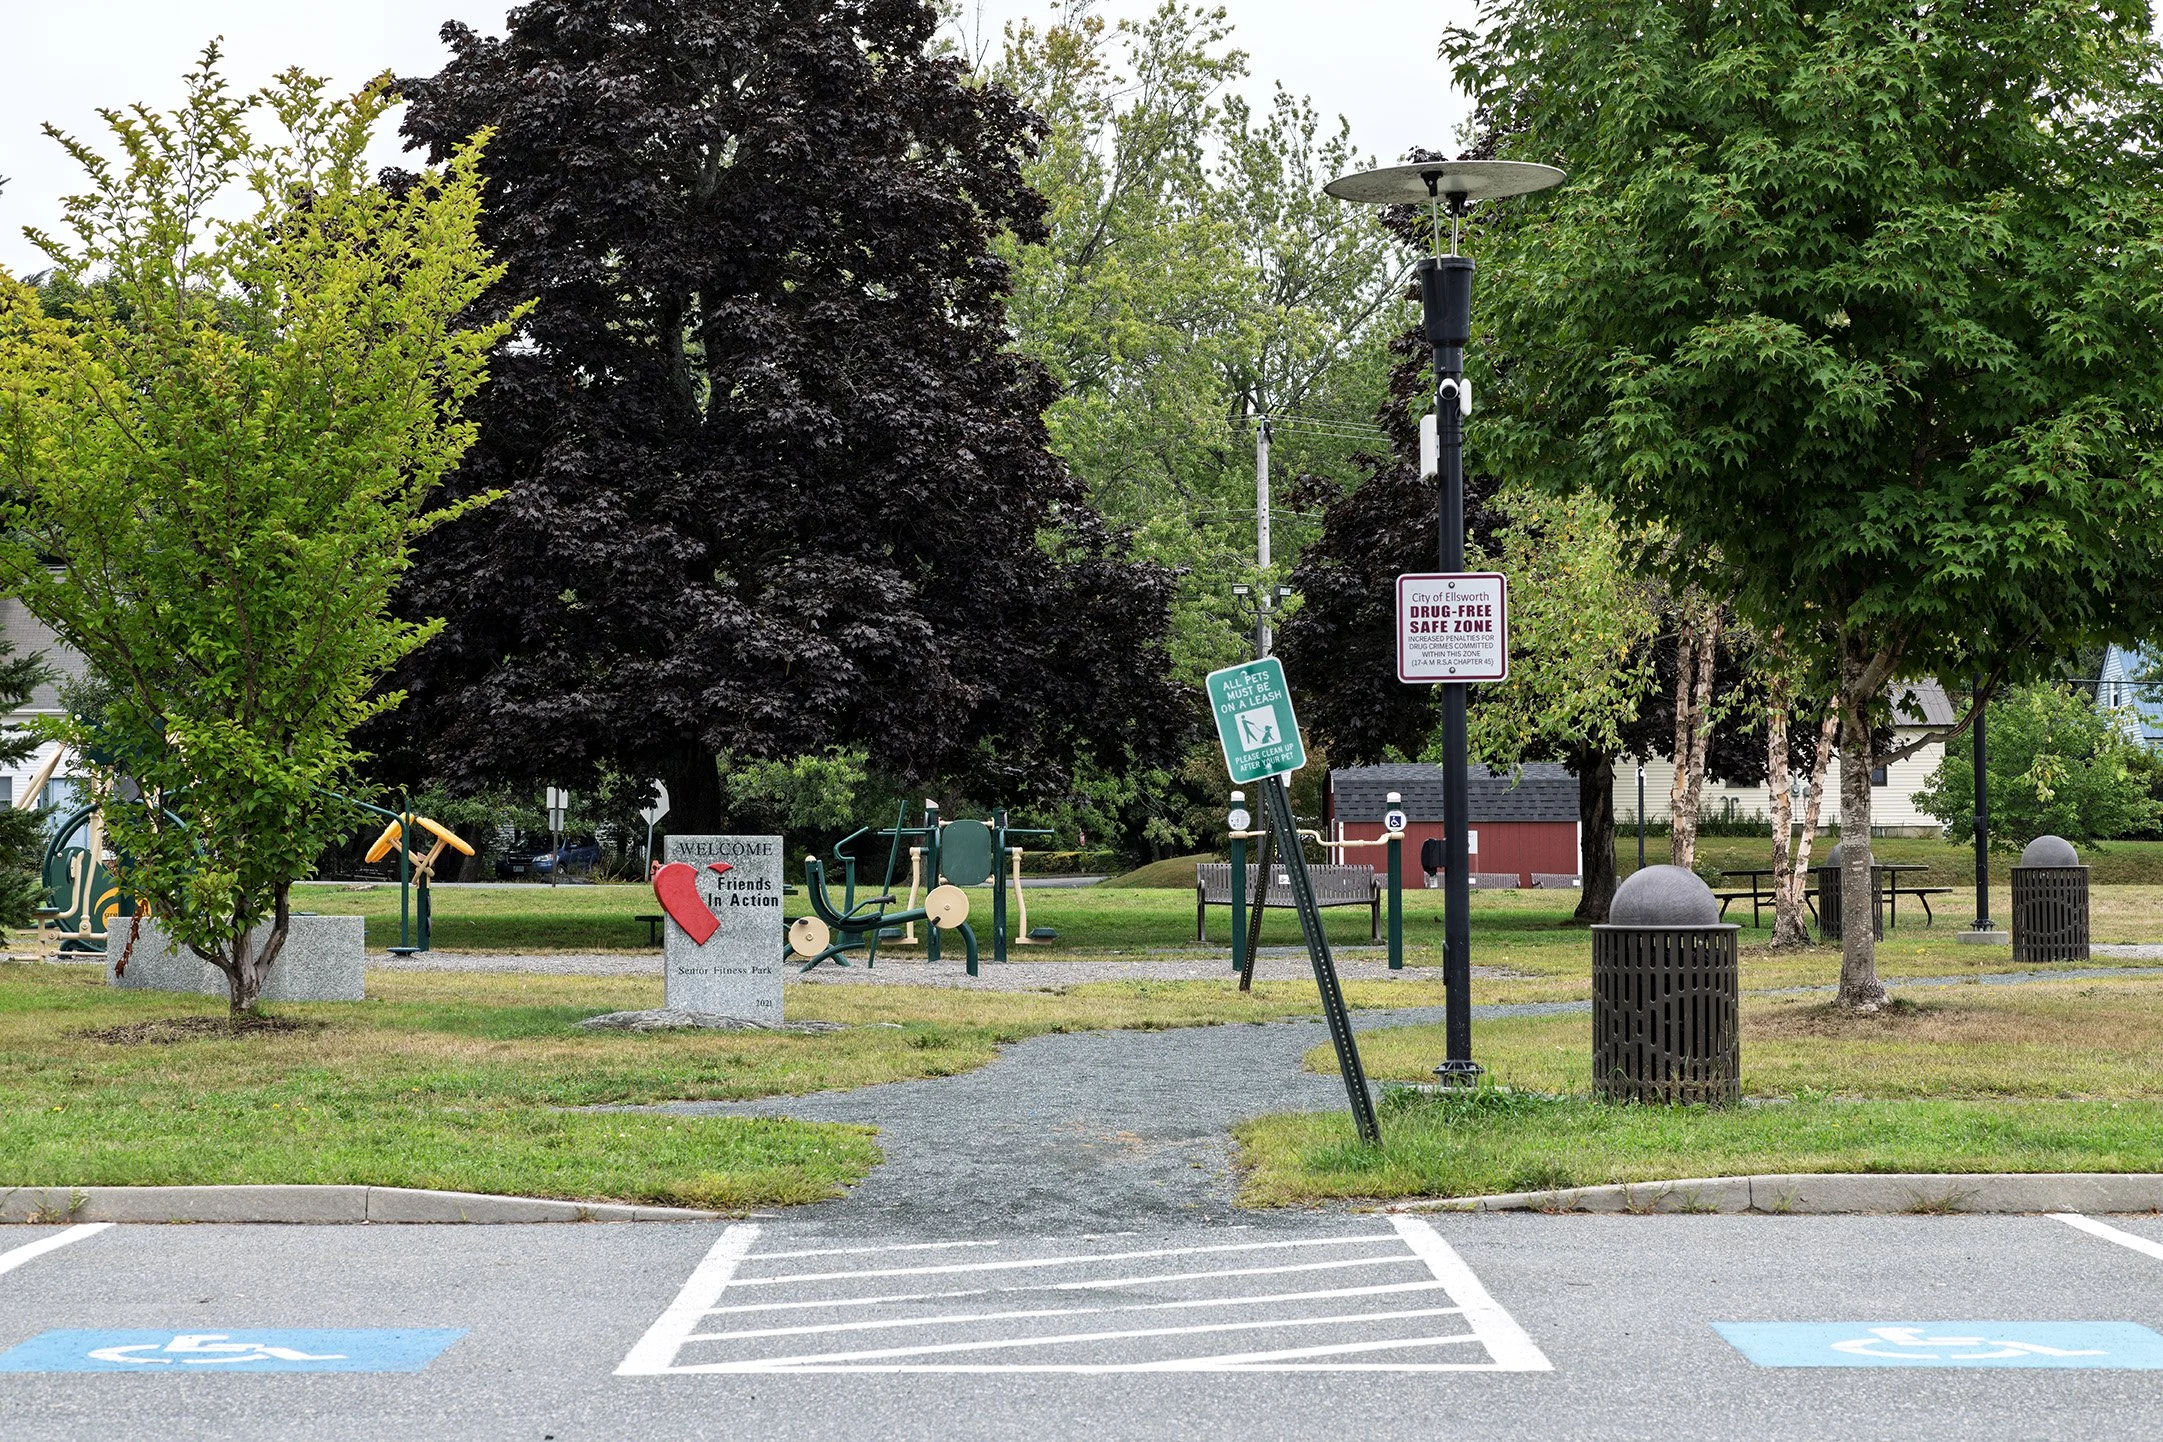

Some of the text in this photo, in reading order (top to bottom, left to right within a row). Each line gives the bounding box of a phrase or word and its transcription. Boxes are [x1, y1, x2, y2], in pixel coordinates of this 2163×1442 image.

[1412, 592, 1490, 604] City of Ellsworth
[1410, 605, 1492, 618] DRUG-FREE
[1410, 620, 1493, 634] SAFE ZONE
[1484, 658, 1494, 666] 45)
[1223, 671, 1269, 691] ALL PETS
[1226, 682, 1271, 701] MUST BE
[1221, 691, 1282, 714] ON A LEASH
[1235, 743, 1294, 764] PLEASE CLEAN UP
[1240, 752, 1294, 772] AFTER YOUR PET
[678, 842, 773, 857] WELCOME
[717, 877, 772, 891] Friends
[708, 893, 779, 907] In Action
[678, 965, 772, 975] Senior Fitness Park
[755, 999, 772, 1007] 2021
